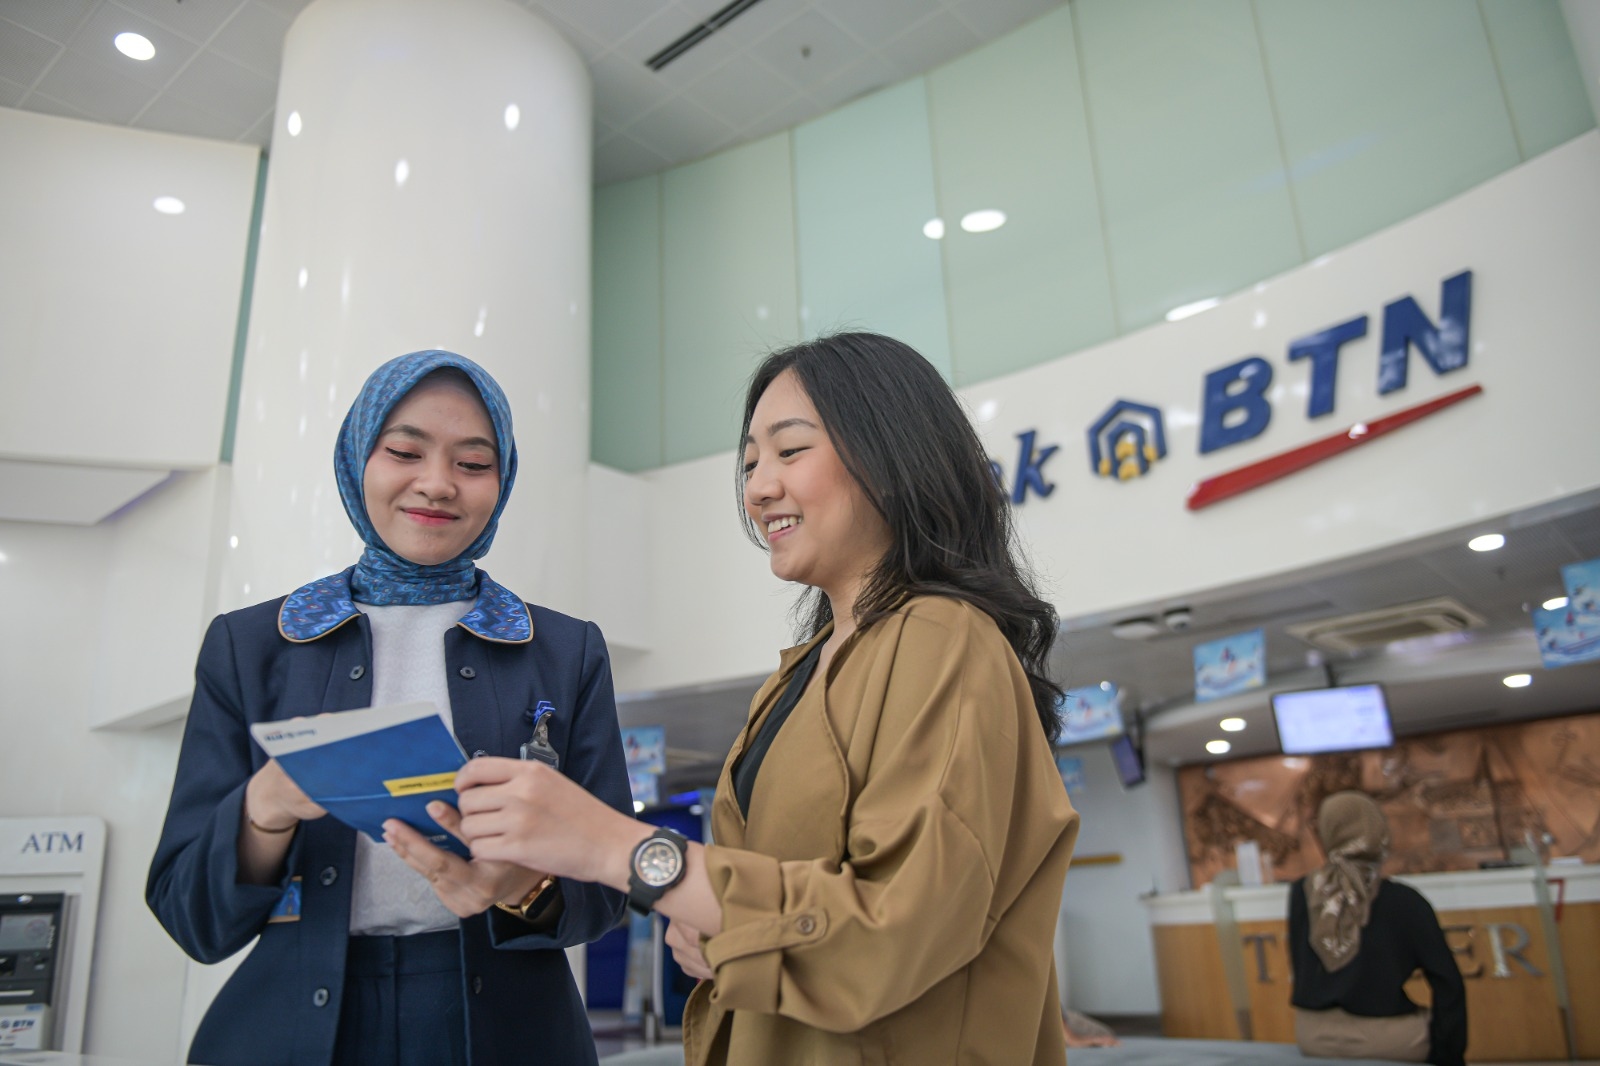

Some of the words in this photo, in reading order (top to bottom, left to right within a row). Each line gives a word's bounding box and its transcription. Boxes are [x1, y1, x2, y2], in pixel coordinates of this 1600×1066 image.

[1197, 269, 1473, 455] BTN
[21, 831, 85, 853] ATM
[1242, 922, 1545, 984] TER
